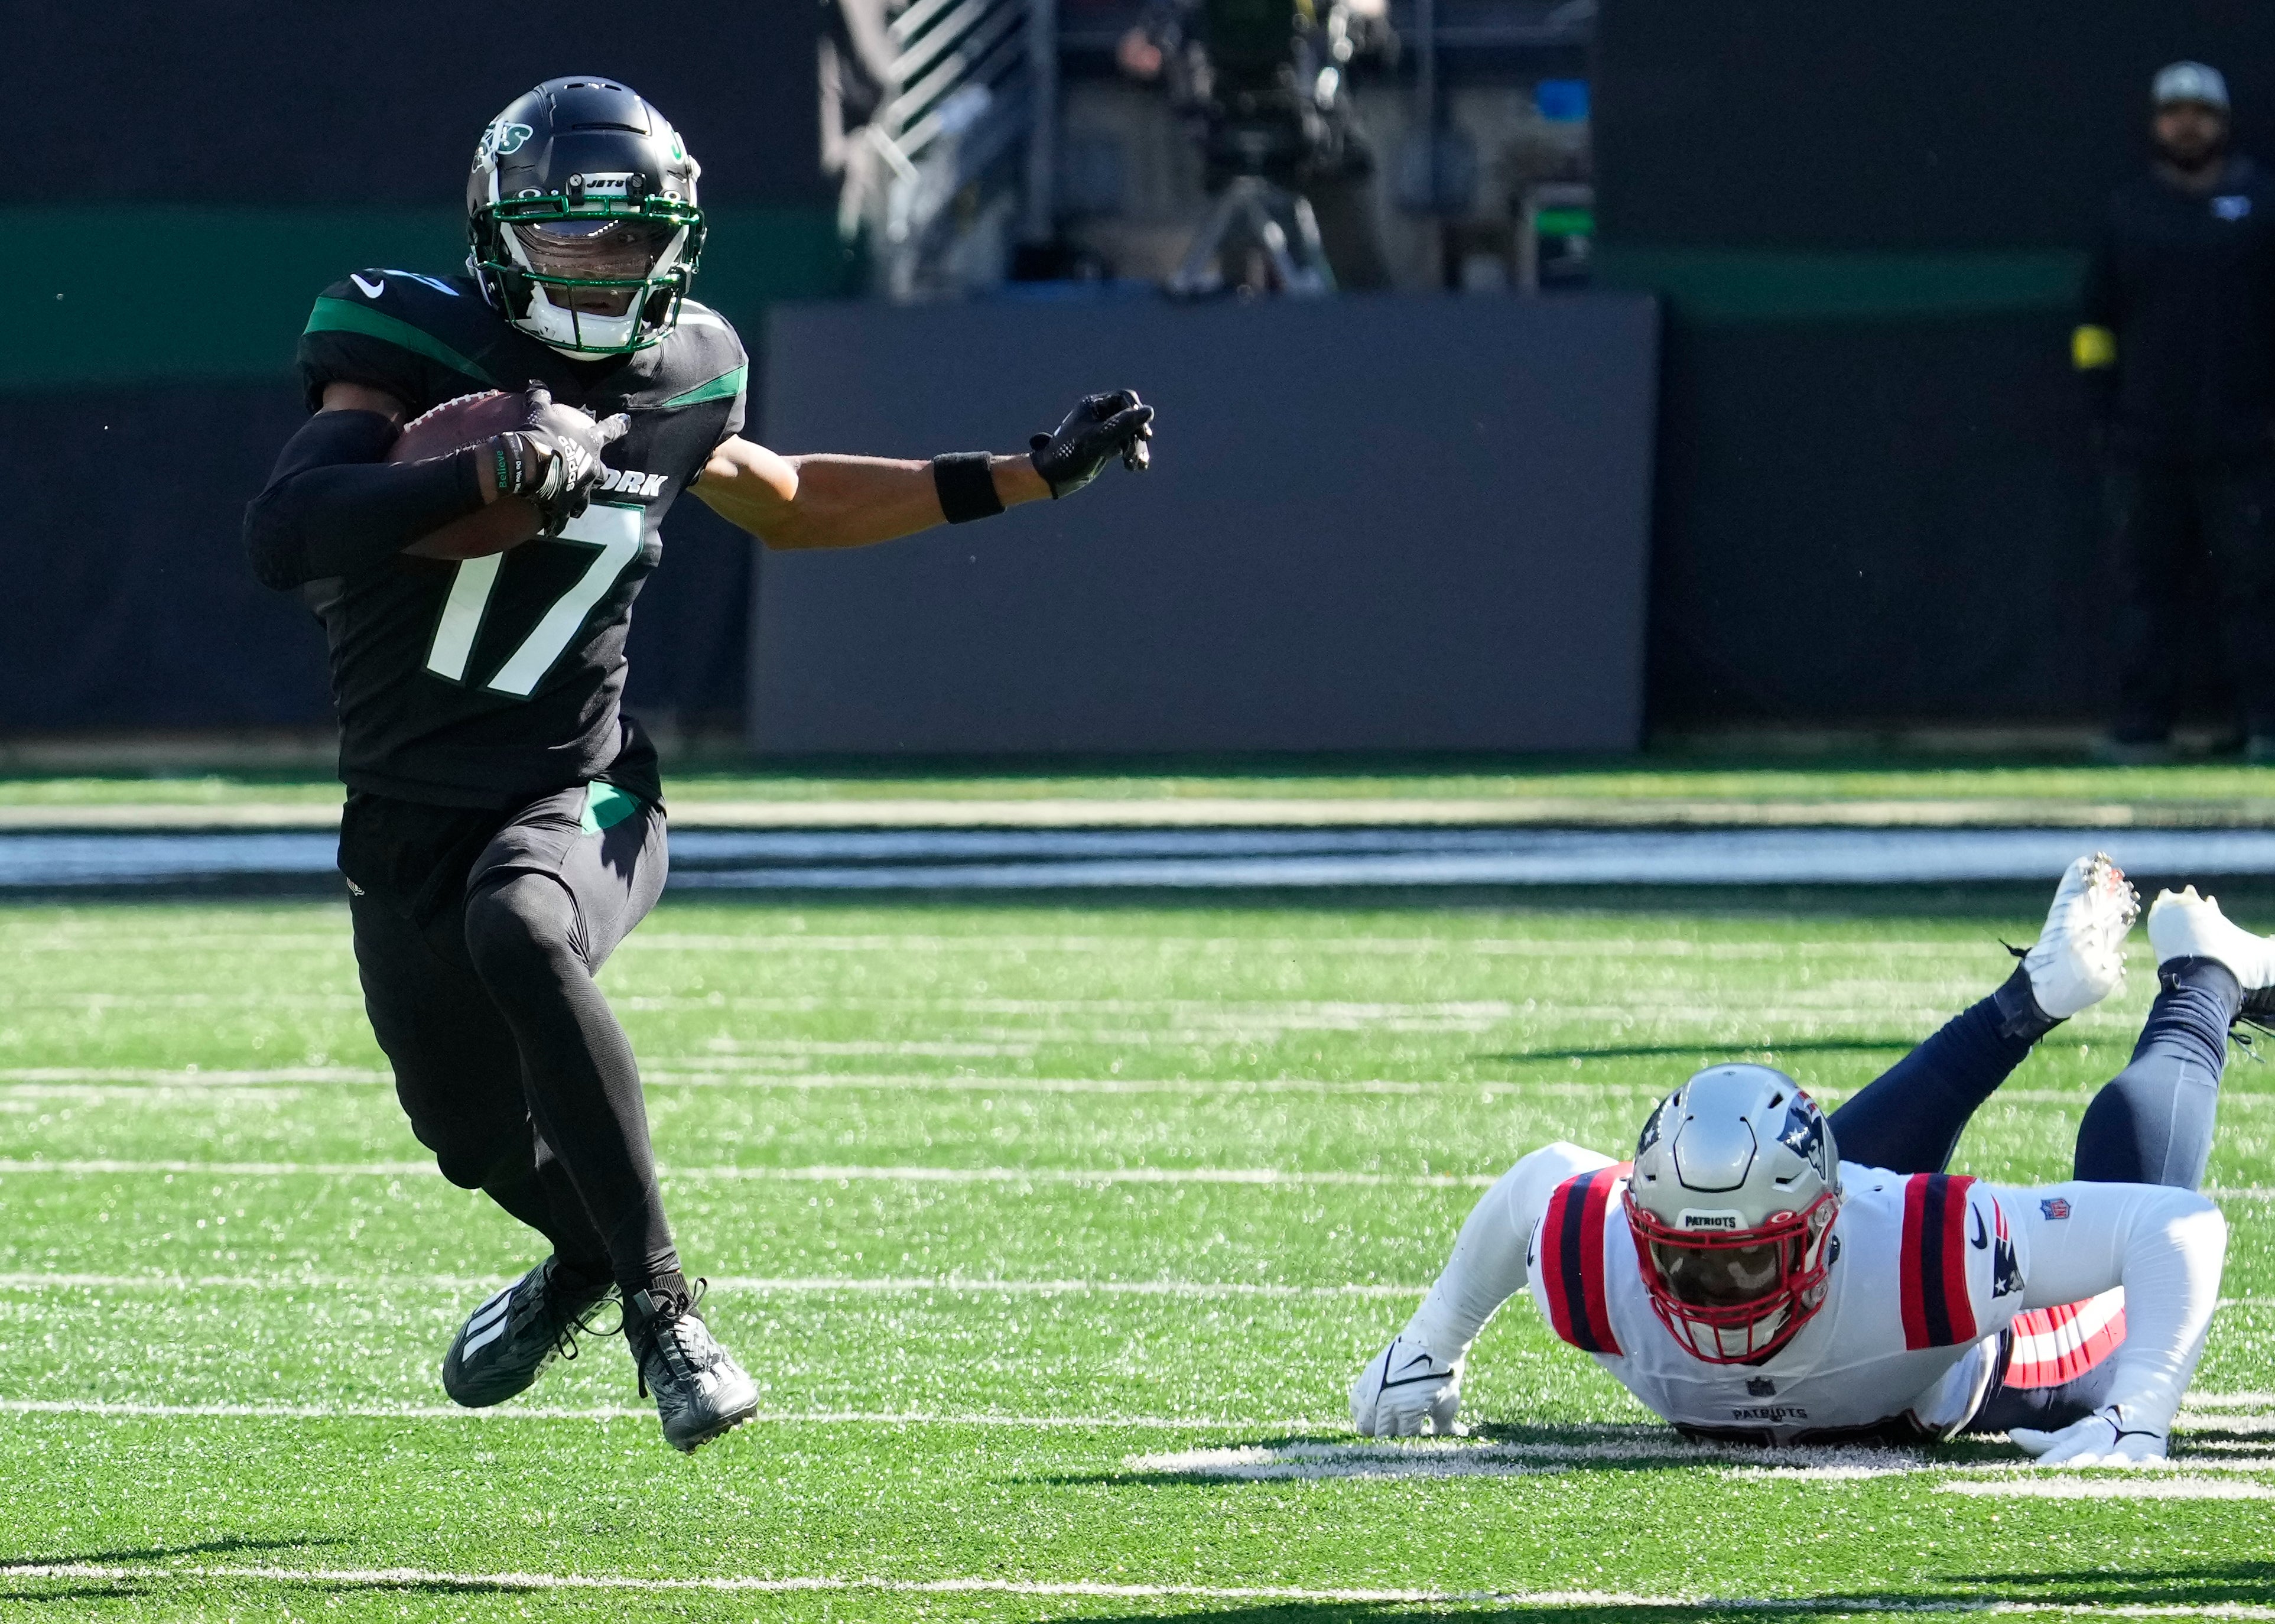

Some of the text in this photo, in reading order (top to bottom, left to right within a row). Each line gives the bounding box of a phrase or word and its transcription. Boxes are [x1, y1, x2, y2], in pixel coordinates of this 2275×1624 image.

[586, 180, 625, 189] JETS
[496, 450, 508, 489] Believe
[515, 460, 522, 470] Do
[558, 435, 578, 492] adidas
[599, 467, 669, 497] ORK
[424, 502, 644, 699] 17
[1685, 1216, 1736, 1229] PATRIOTS
[1732, 1408, 1808, 1422] PATRIOTS
